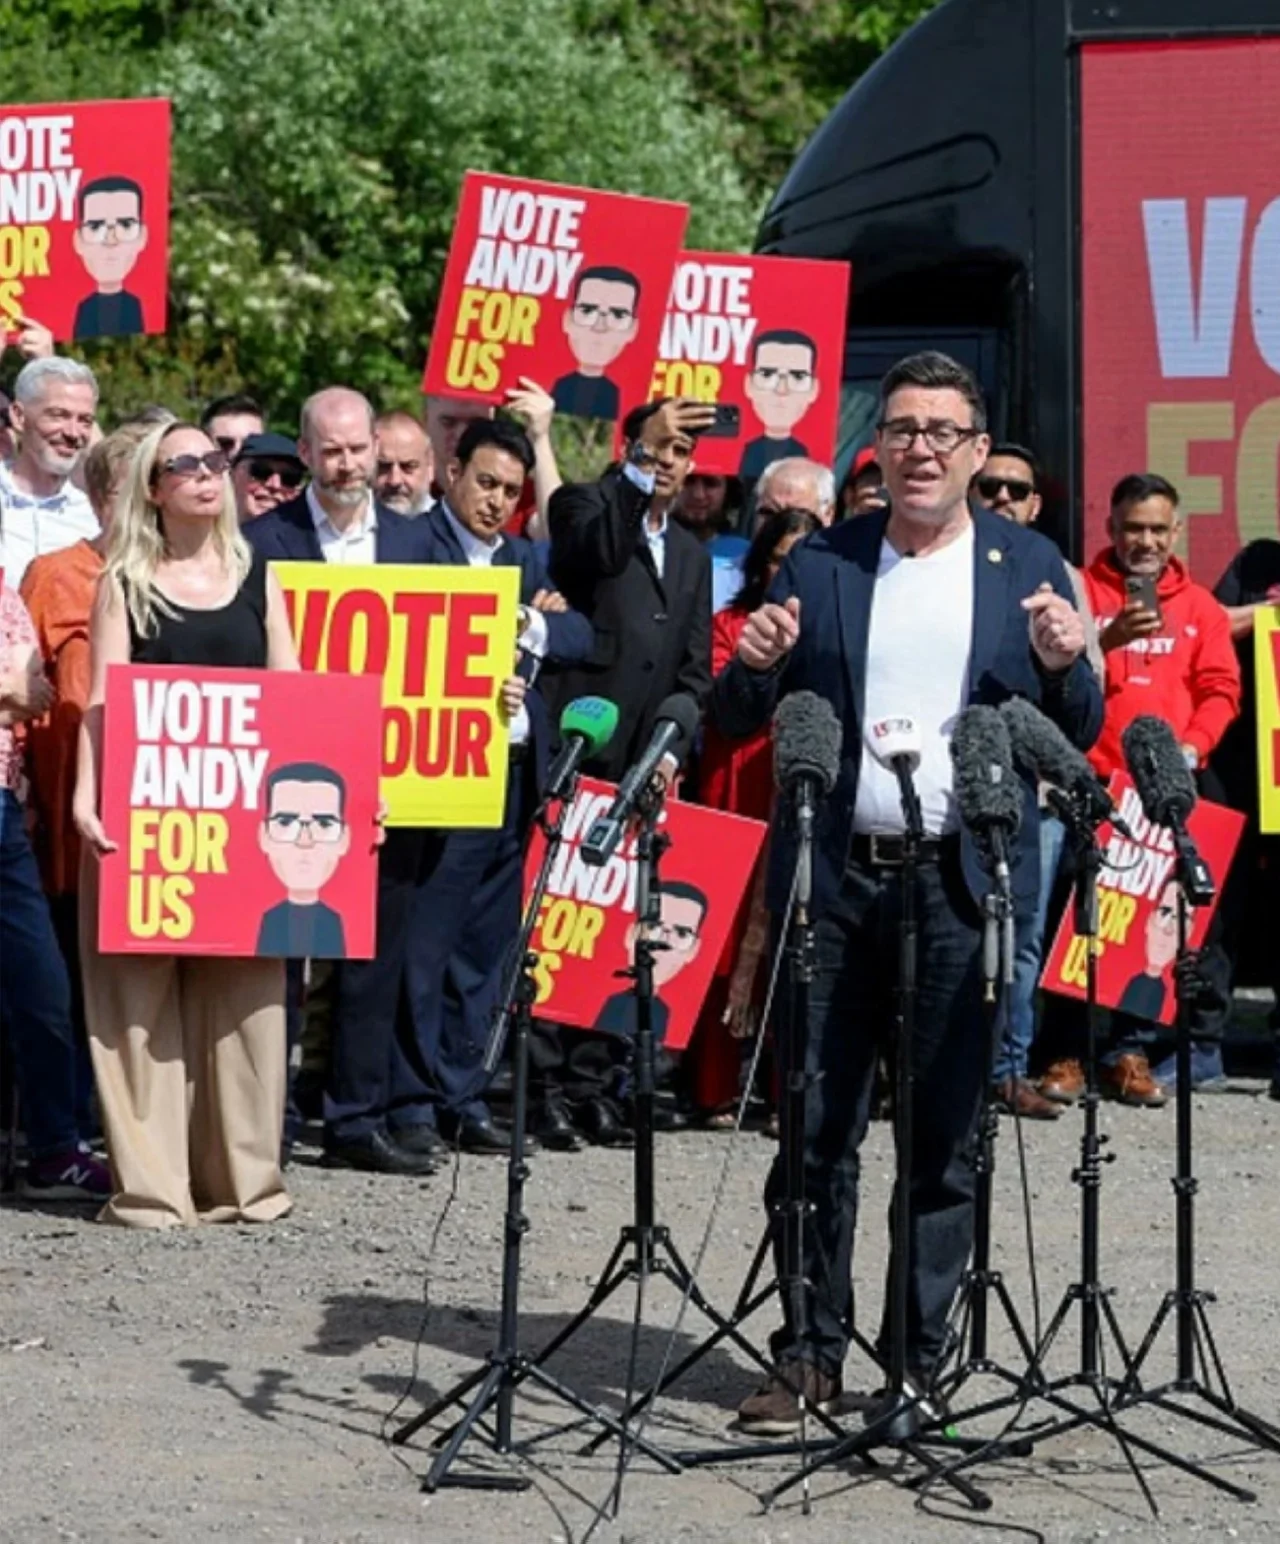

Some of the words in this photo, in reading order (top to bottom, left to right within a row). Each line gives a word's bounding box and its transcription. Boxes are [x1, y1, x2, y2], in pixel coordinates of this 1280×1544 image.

[0, 115, 73, 171] OTE
[0, 168, 82, 225] NDY
[481, 186, 586, 249] VOTE
[0, 224, 50, 280] OR
[464, 240, 584, 300] ANDY
[456, 288, 540, 346] FOR
[667, 261, 754, 317] OTE
[446, 338, 505, 392] US
[132, 678, 261, 745] VOTE
[380, 705, 492, 778] OUR
[129, 746, 269, 810] ANDY
[129, 809, 228, 875] FOR
[128, 874, 194, 940] US
